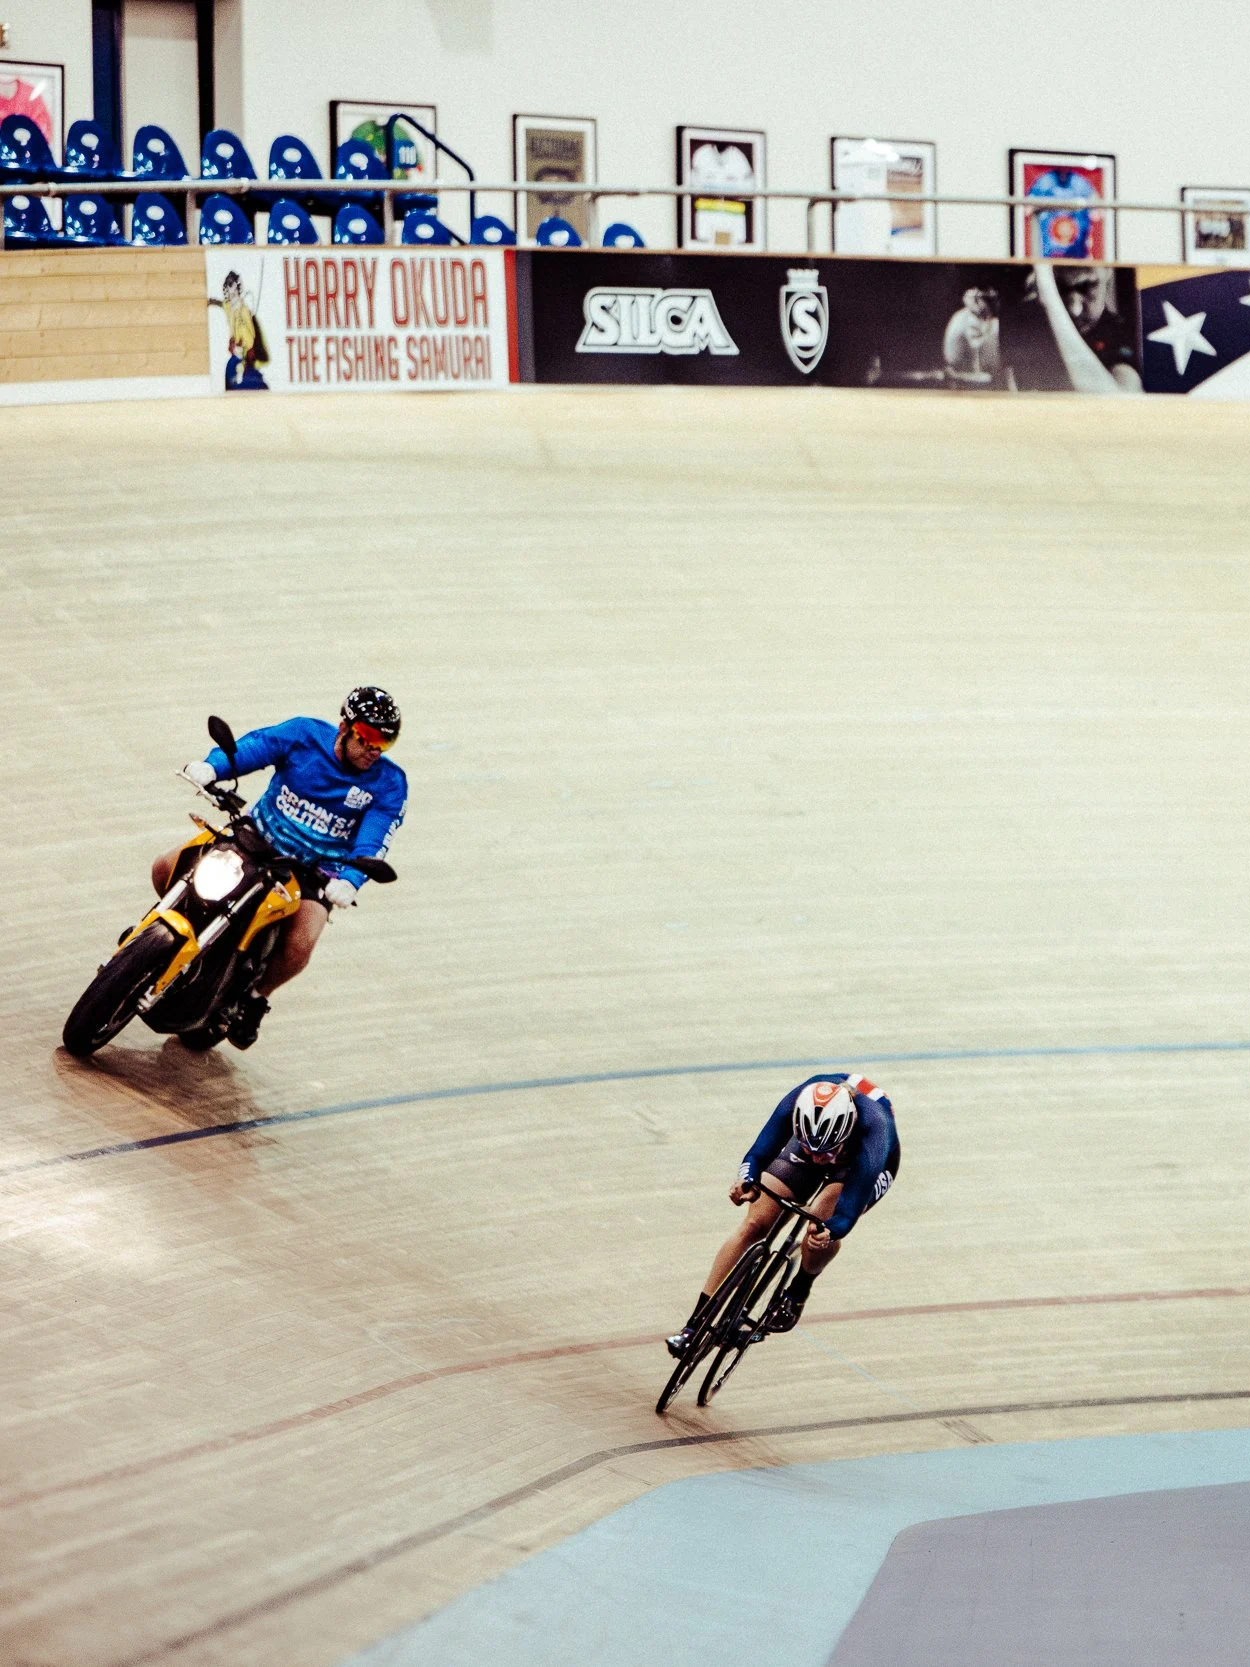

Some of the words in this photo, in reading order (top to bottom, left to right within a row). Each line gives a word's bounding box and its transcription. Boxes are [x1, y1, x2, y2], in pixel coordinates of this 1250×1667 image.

[283, 257, 378, 328] HARRY
[389, 258, 489, 328] OKUDA
[577, 288, 738, 353] SILCA
[286, 336, 320, 382] THE
[325, 335, 400, 381] FISHING
[406, 334, 492, 380] SAMURAI
